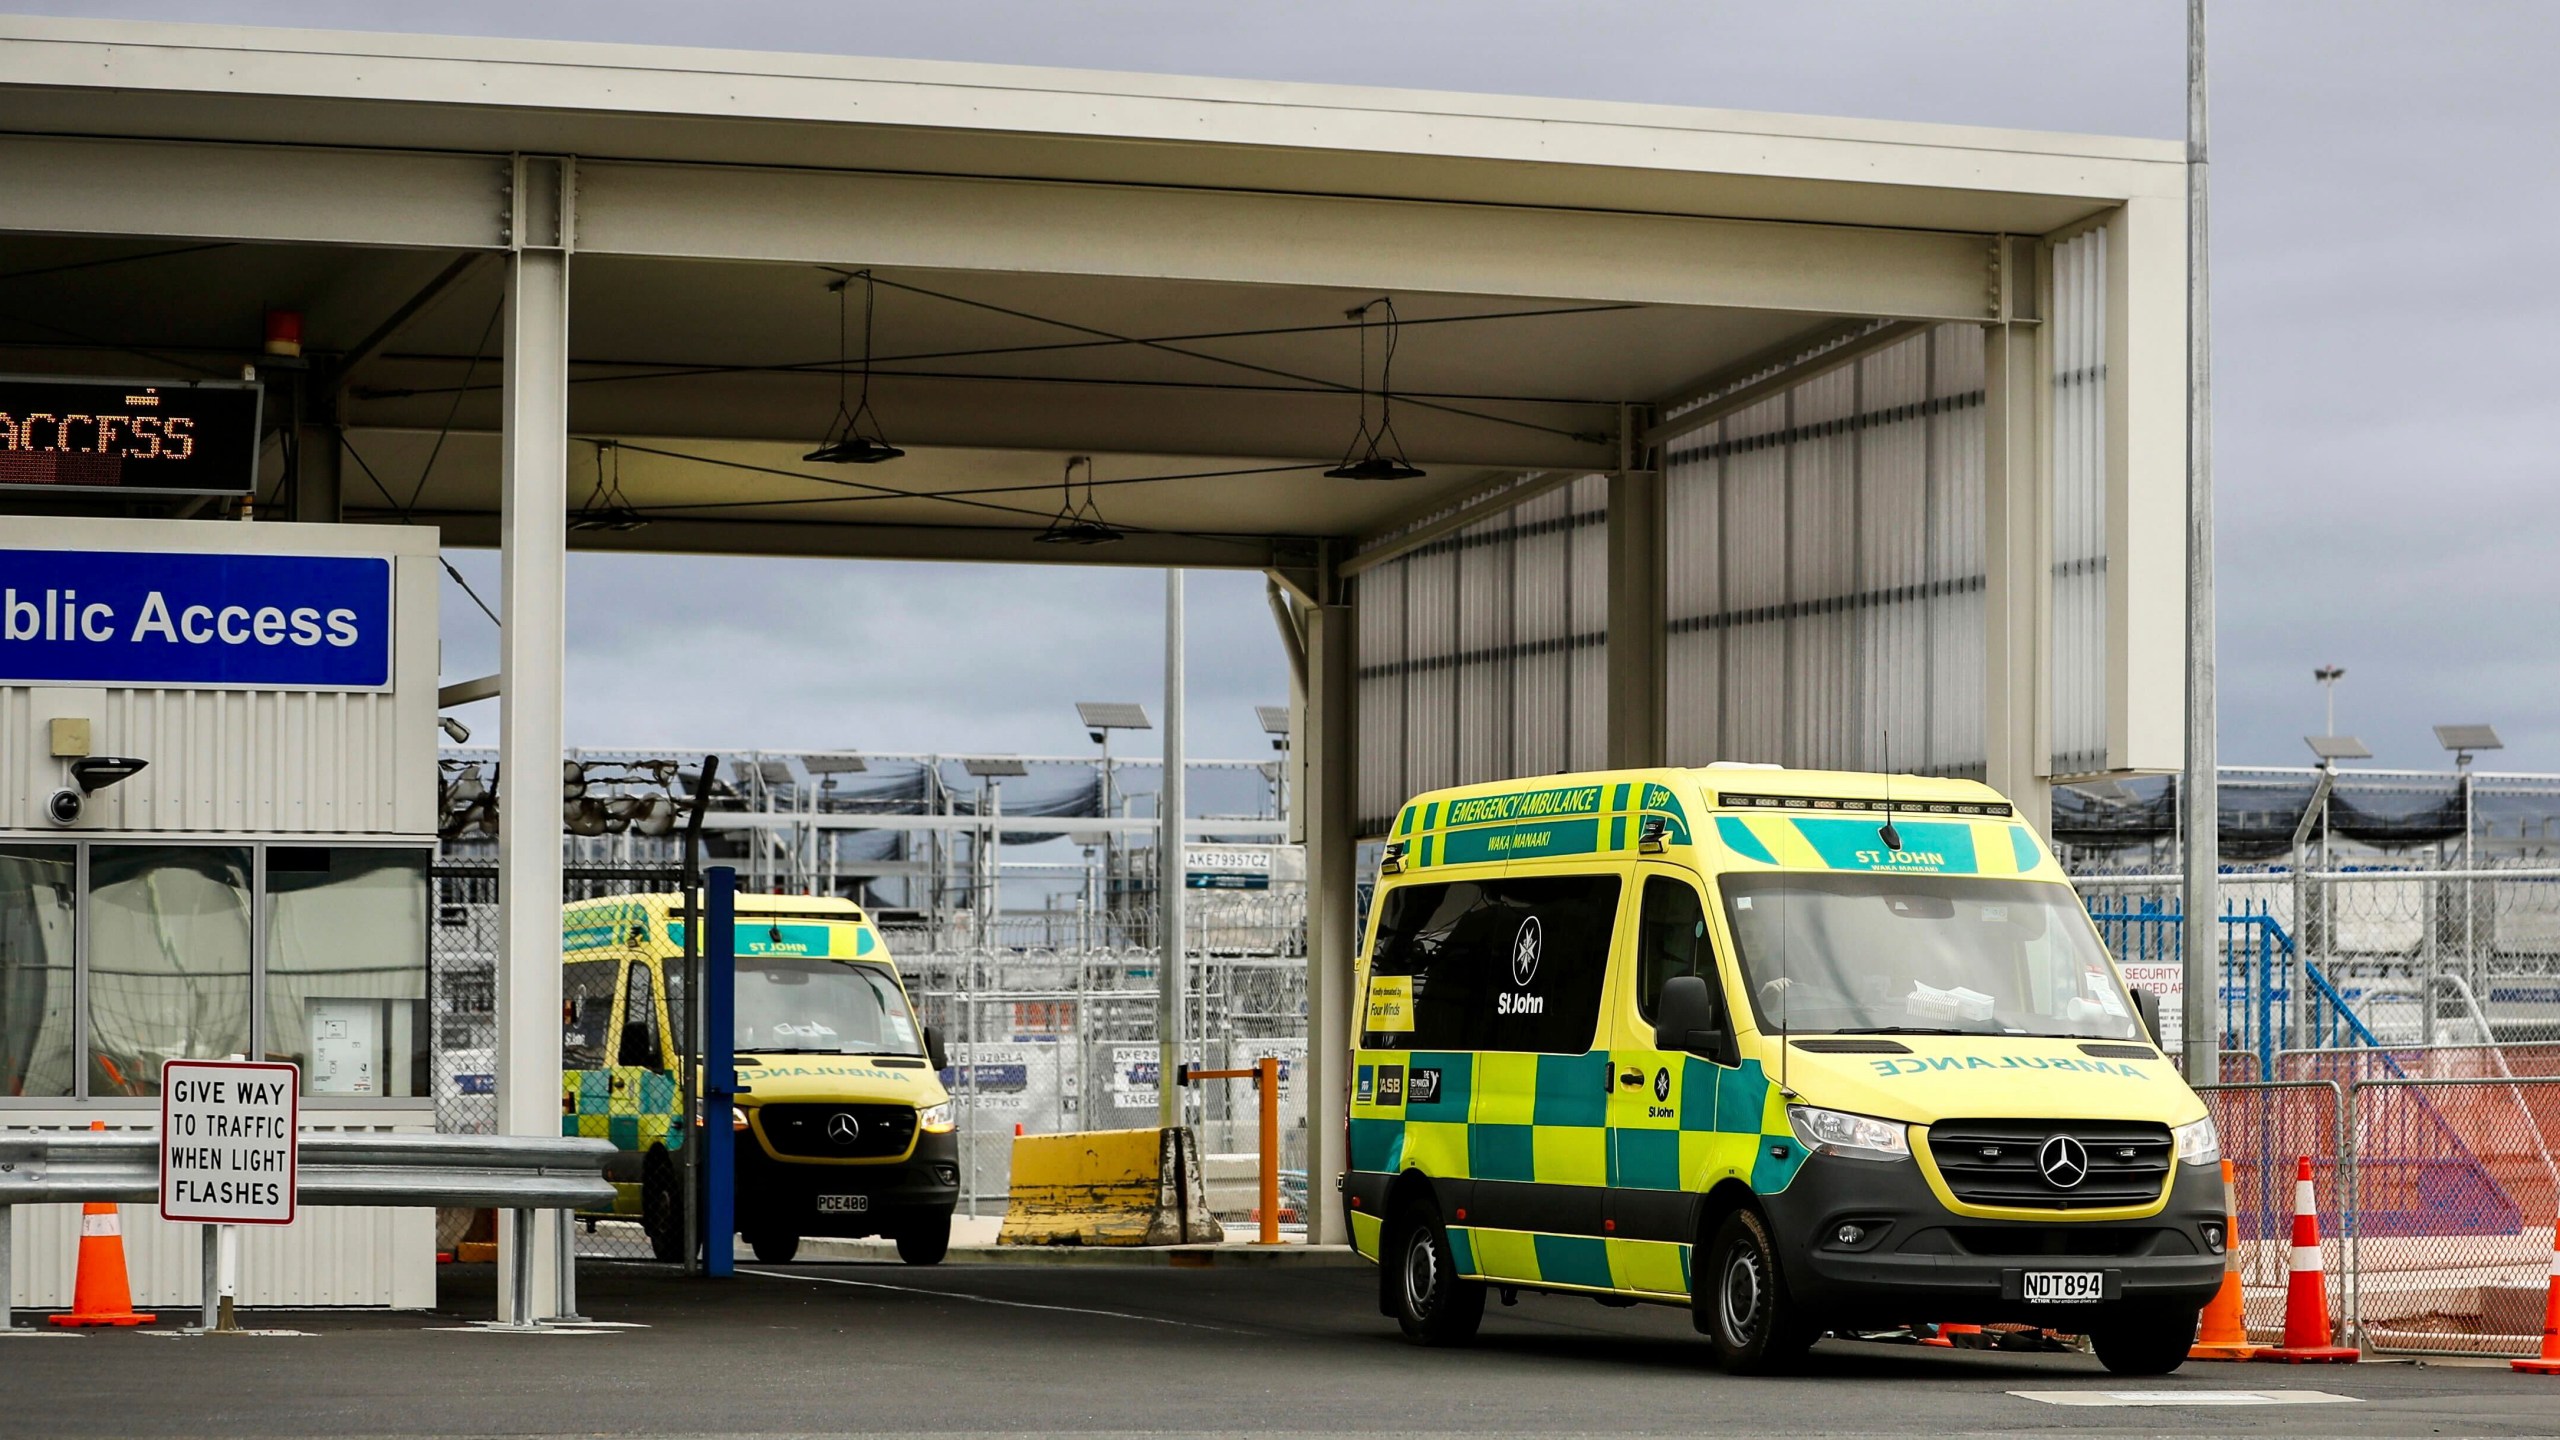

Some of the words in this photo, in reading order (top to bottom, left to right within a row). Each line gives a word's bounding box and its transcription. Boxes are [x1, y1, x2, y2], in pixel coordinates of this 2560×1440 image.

[4, 588, 115, 642] blic
[130, 590, 359, 647] Access
[1450, 795, 1519, 824] EMERGENCY
[1518, 787, 1598, 813] AMBULANCE
[1650, 790, 1670, 808] 399
[1487, 835, 1510, 852] WAKA
[1512, 830, 1552, 848] MANAAKI
[1855, 850, 1880, 863] ST
[1888, 851, 1945, 865] JOHN
[749, 942, 766, 952] ST
[770, 943, 808, 952] JOHN
[2125, 968, 2180, 980] SECURITY
[1498, 992, 1511, 1015] St
[1511, 992, 1544, 1014] John
[174, 1079, 226, 1104] GIVE
[237, 1081, 286, 1106] WAY
[1380, 1078, 1401, 1093] ASB
[1648, 1106, 1656, 1118] St
[1657, 1106, 1674, 1118] John
[173, 1113, 197, 1136] TO
[206, 1114, 285, 1139] TRAFFIC
[171, 1146, 222, 1170] WHEN
[231, 1148, 286, 1172] LIGHT
[175, 1179, 280, 1206] FLASHES
[2025, 1274, 2100, 1296] NDT894
